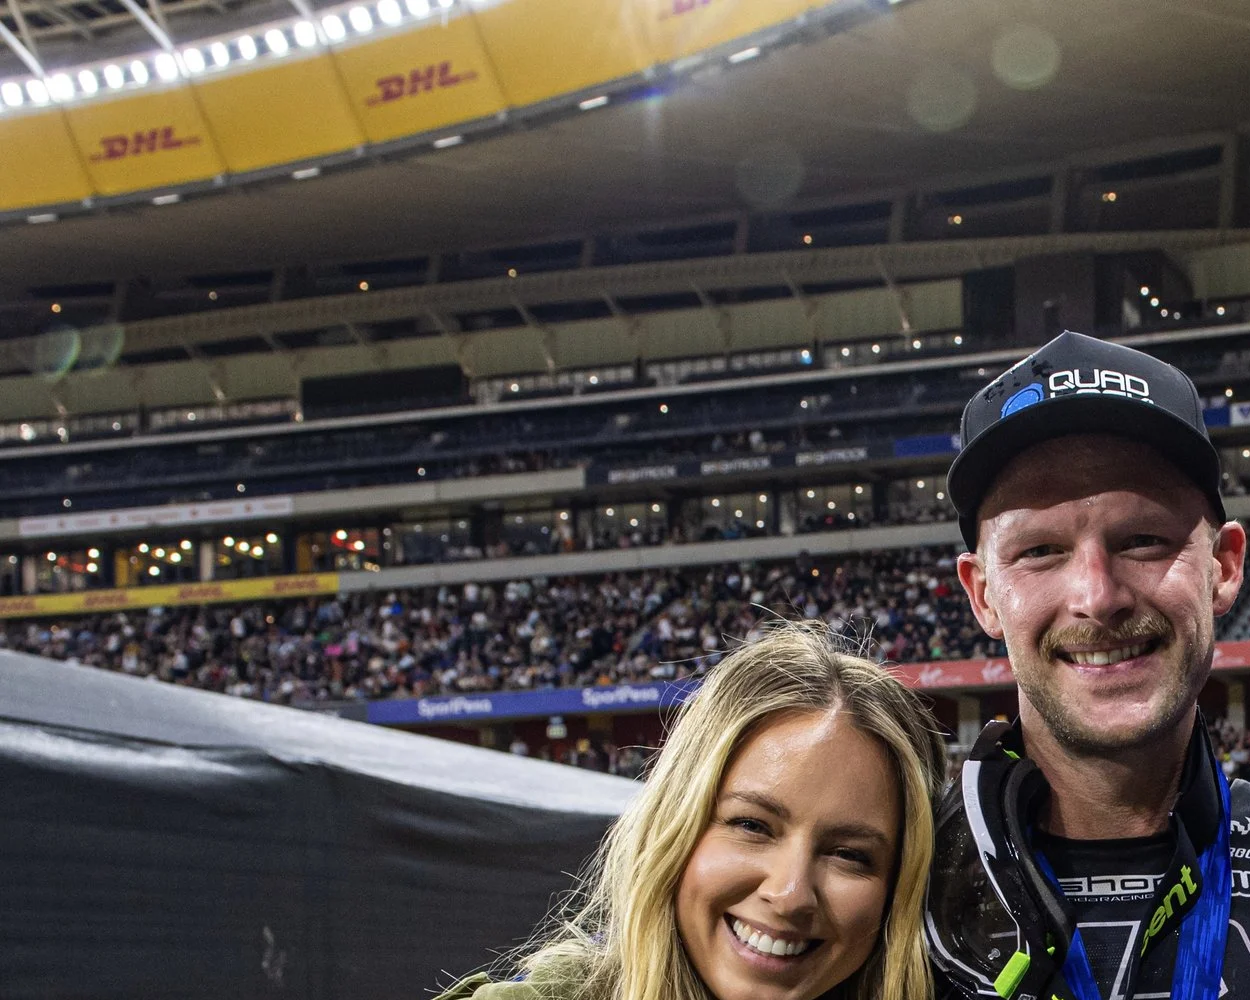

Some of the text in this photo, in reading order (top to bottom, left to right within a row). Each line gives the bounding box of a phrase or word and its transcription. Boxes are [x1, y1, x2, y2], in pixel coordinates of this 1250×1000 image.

[376, 61, 463, 101] DHL
[101, 125, 184, 160] DHL
[1049, 369, 1150, 397] QUAD
